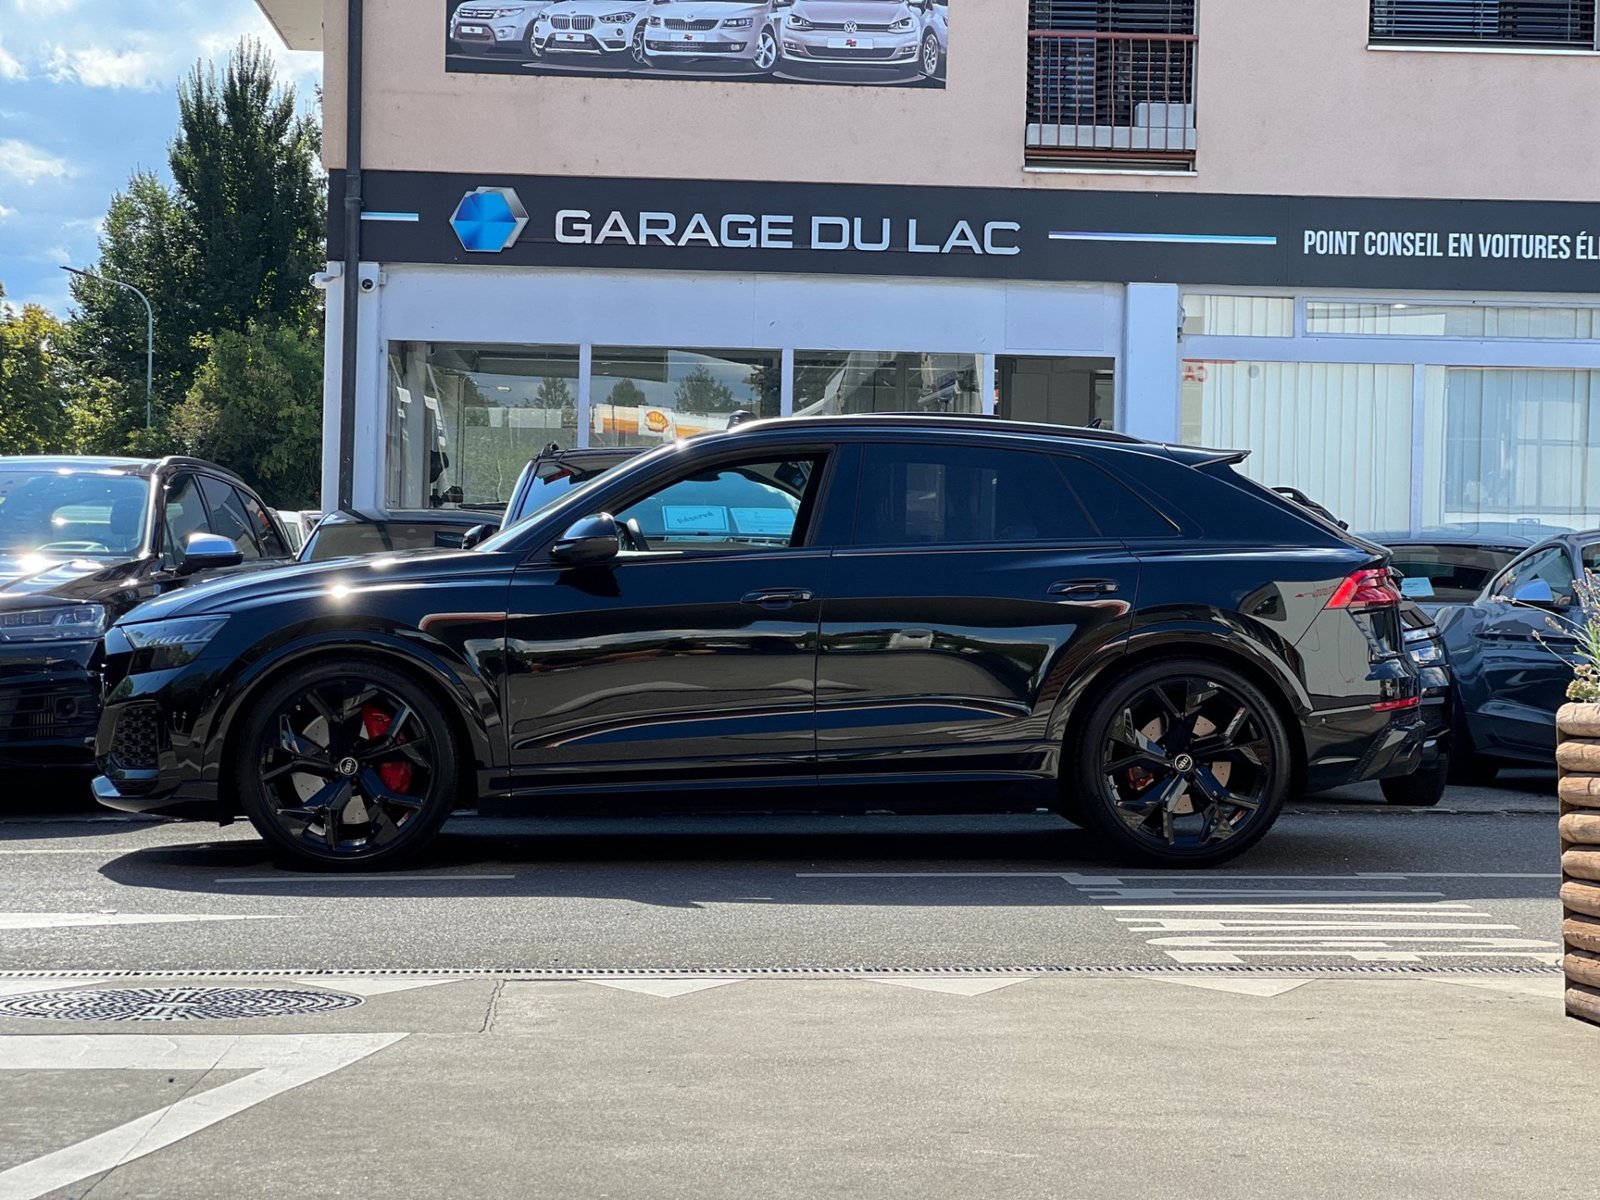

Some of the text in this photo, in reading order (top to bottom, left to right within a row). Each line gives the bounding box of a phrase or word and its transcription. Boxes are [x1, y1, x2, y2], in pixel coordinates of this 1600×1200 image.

[555, 209, 1021, 255] GARAGE DU LAC
[1303, 230, 1600, 260] POINT CONSEIL EN VOITURES ÉL
